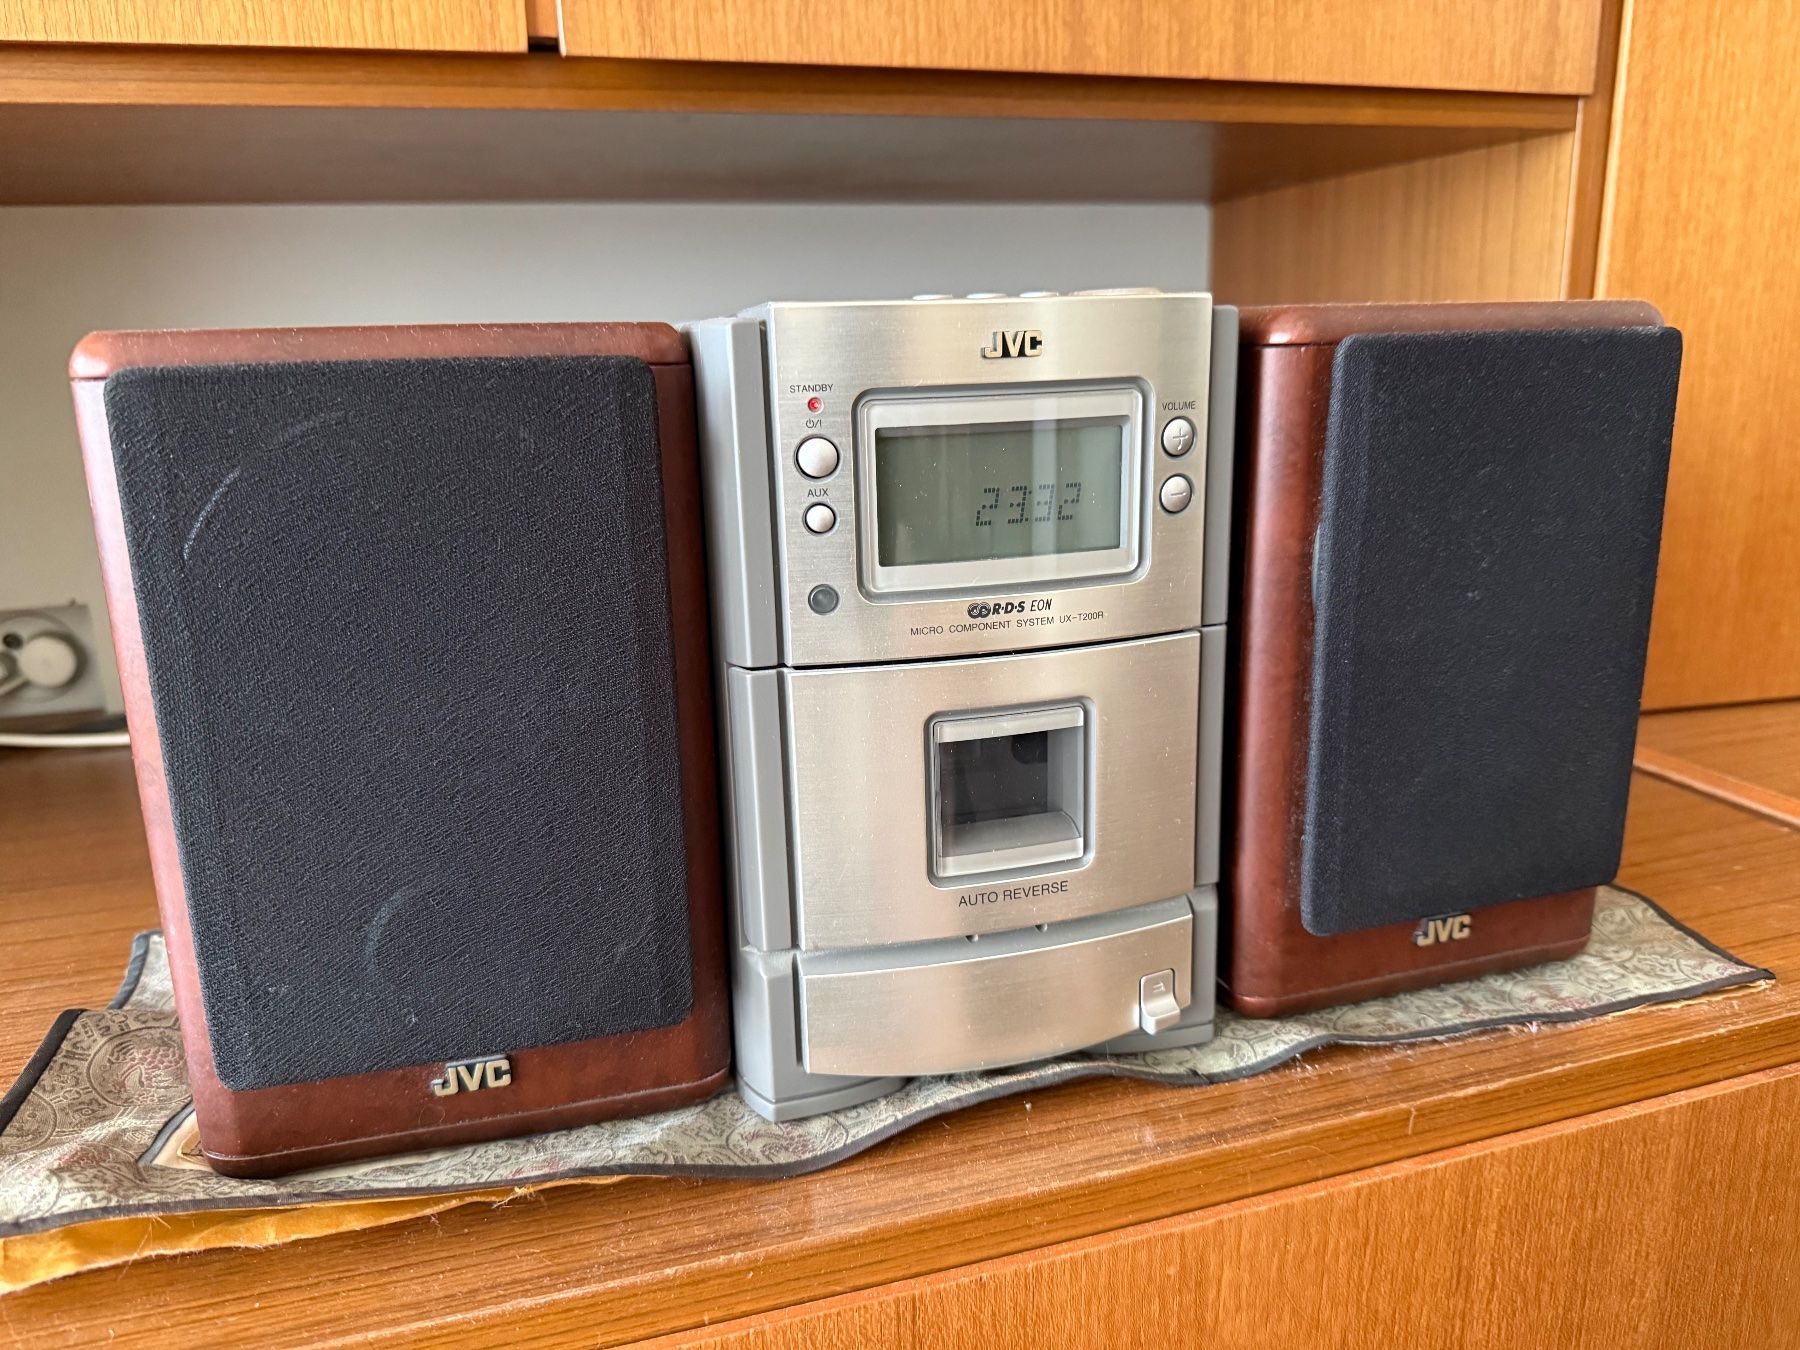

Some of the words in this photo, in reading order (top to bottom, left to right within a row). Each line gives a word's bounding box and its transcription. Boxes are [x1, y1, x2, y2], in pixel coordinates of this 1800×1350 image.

[983, 329, 1042, 359] JVC
[789, 383, 834, 394] STANDBY
[1161, 400, 1197, 411] VOLUME
[806, 487, 829, 498] AUX
[975, 482, 1082, 527] 23:32
[1029, 598, 1053, 612] EON
[910, 625, 944, 636] MICRO
[949, 620, 1011, 634] COMPONENT
[1016, 616, 1055, 628] SYSTEM
[1059, 610, 1104, 624] UX-T200R
[958, 891, 999, 908] AUTO
[1002, 880, 1069, 902] REVERSE
[1415, 914, 1471, 947] JVC
[433, 1058, 512, 1097] JVC
